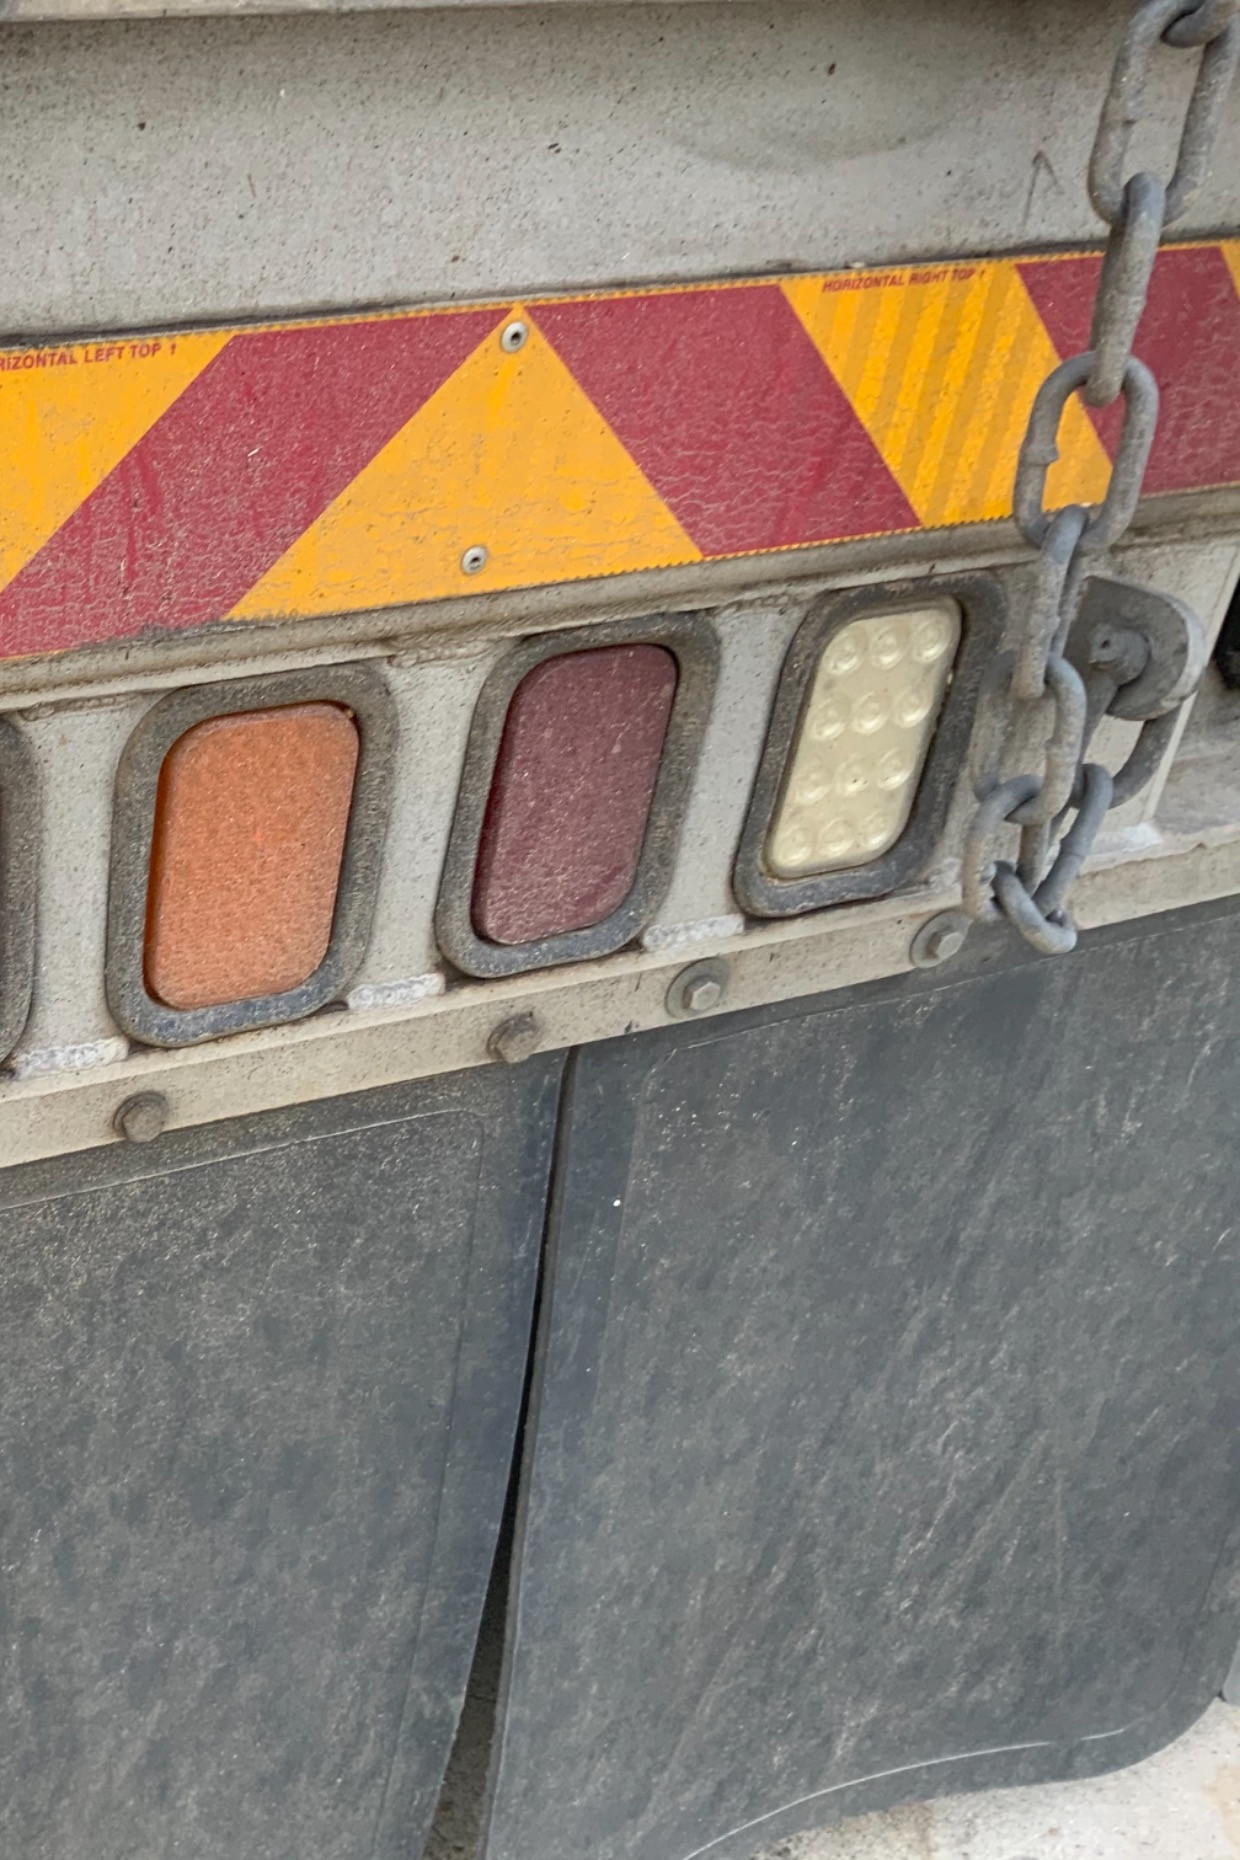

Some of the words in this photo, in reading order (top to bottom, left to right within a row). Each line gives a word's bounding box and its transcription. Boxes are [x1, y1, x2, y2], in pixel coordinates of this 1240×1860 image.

[823, 275, 904, 292] HORIZONTAL
[910, 270, 949, 285] RIGHT
[952, 268, 976, 280] TOP
[84, 347, 124, 363] LEFT
[131, 343, 162, 358] TOP
